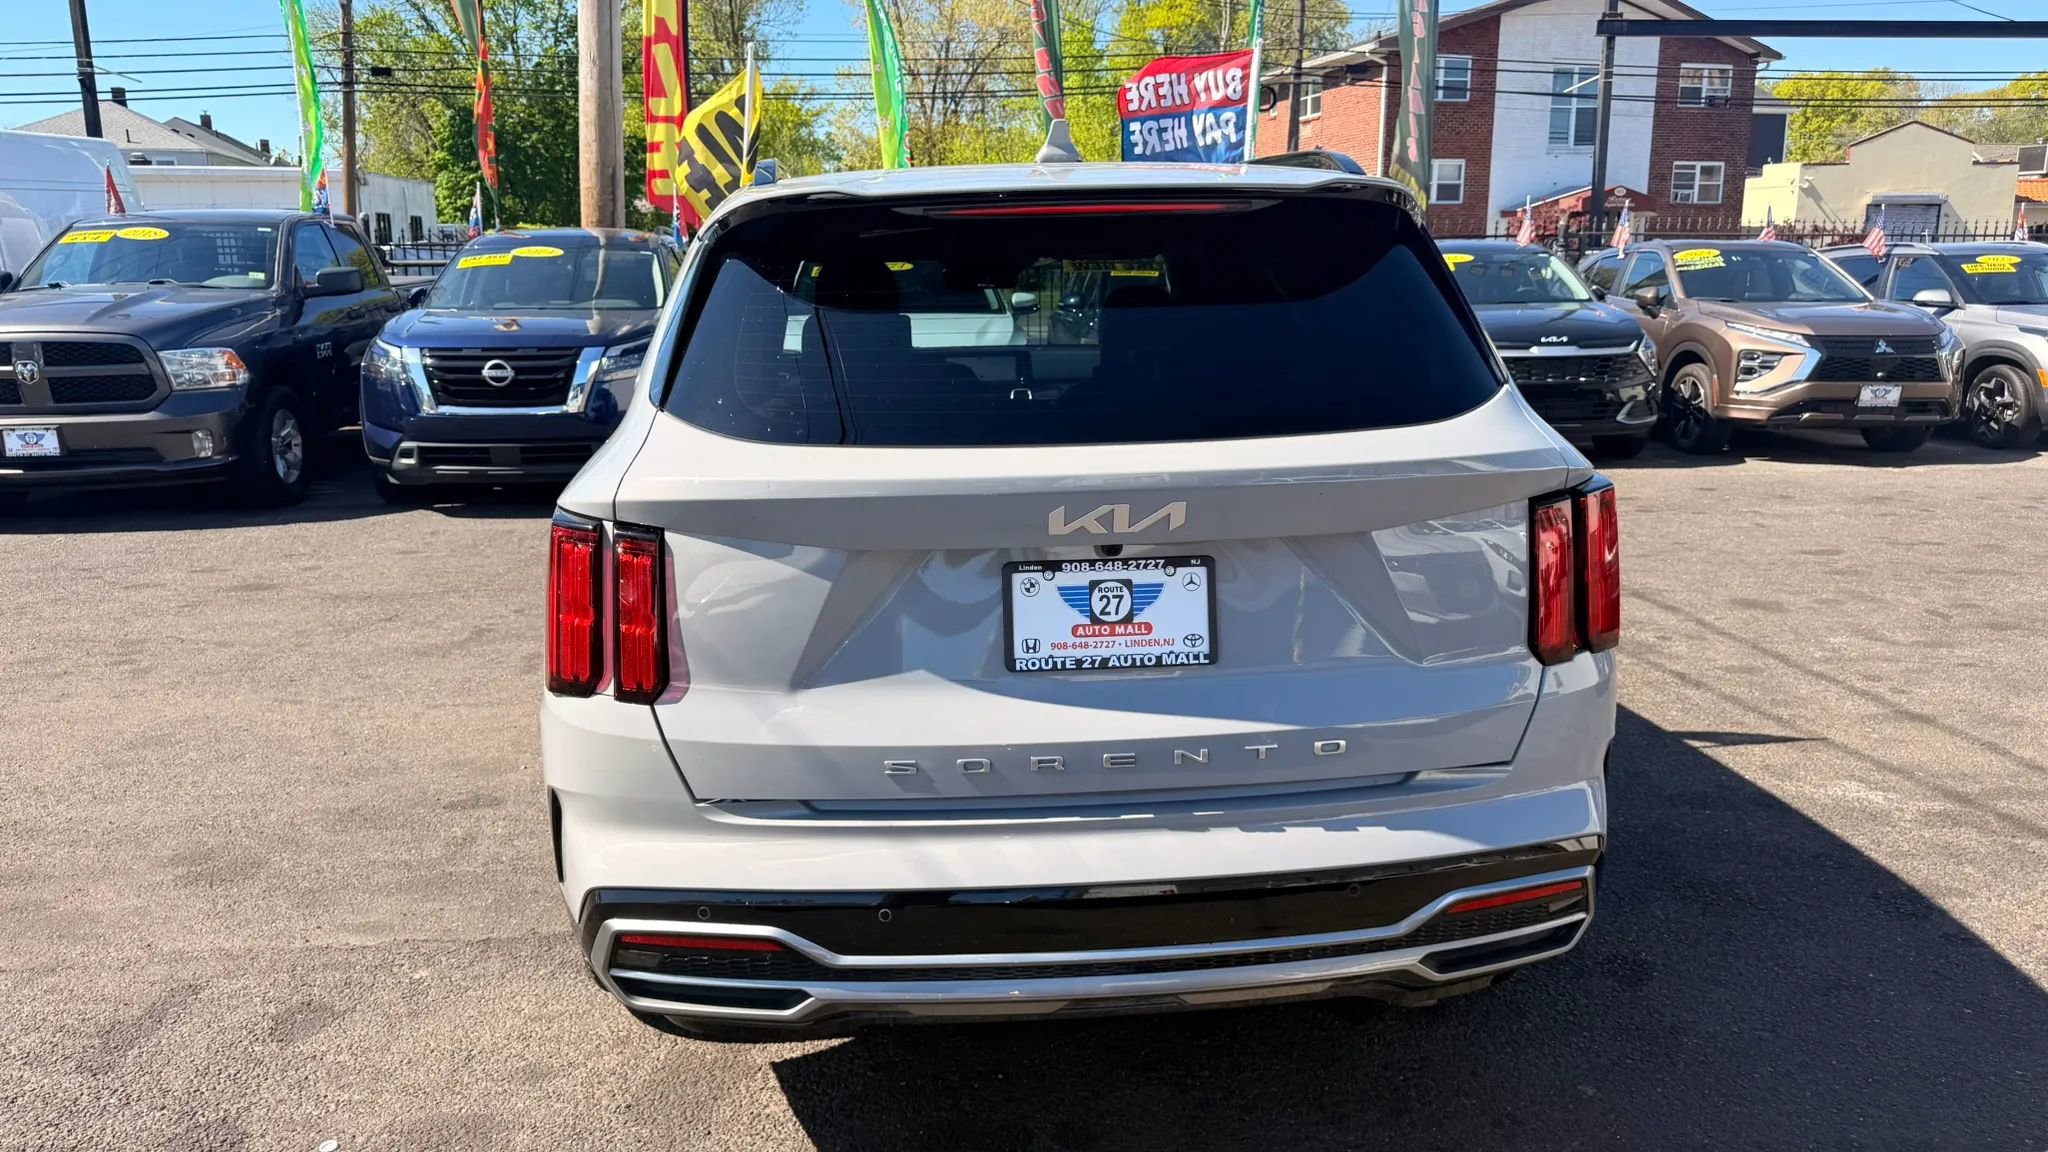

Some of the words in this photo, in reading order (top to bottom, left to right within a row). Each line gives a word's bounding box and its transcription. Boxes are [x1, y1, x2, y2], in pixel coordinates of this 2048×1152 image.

[1540, 335, 1569, 343] KIA
[1048, 501, 1187, 535] KIA
[1061, 559, 1165, 573] 908-648-2727
[1097, 586, 1124, 594] ROUTE
[1098, 594, 1125, 616] 27
[1076, 625, 1111, 636] AUTO
[1115, 624, 1149, 635] MALL
[1050, 640, 1116, 651] 908-648-2727
[1124, 638, 1175, 648] LINDEN,NJ
[1015, 656, 1077, 671] ROUTE
[1081, 655, 1102, 669] 27
[1107, 653, 1157, 667] AUTO
[1161, 652, 1210, 666] MALL
[883, 739, 1347, 776] SORENTO
